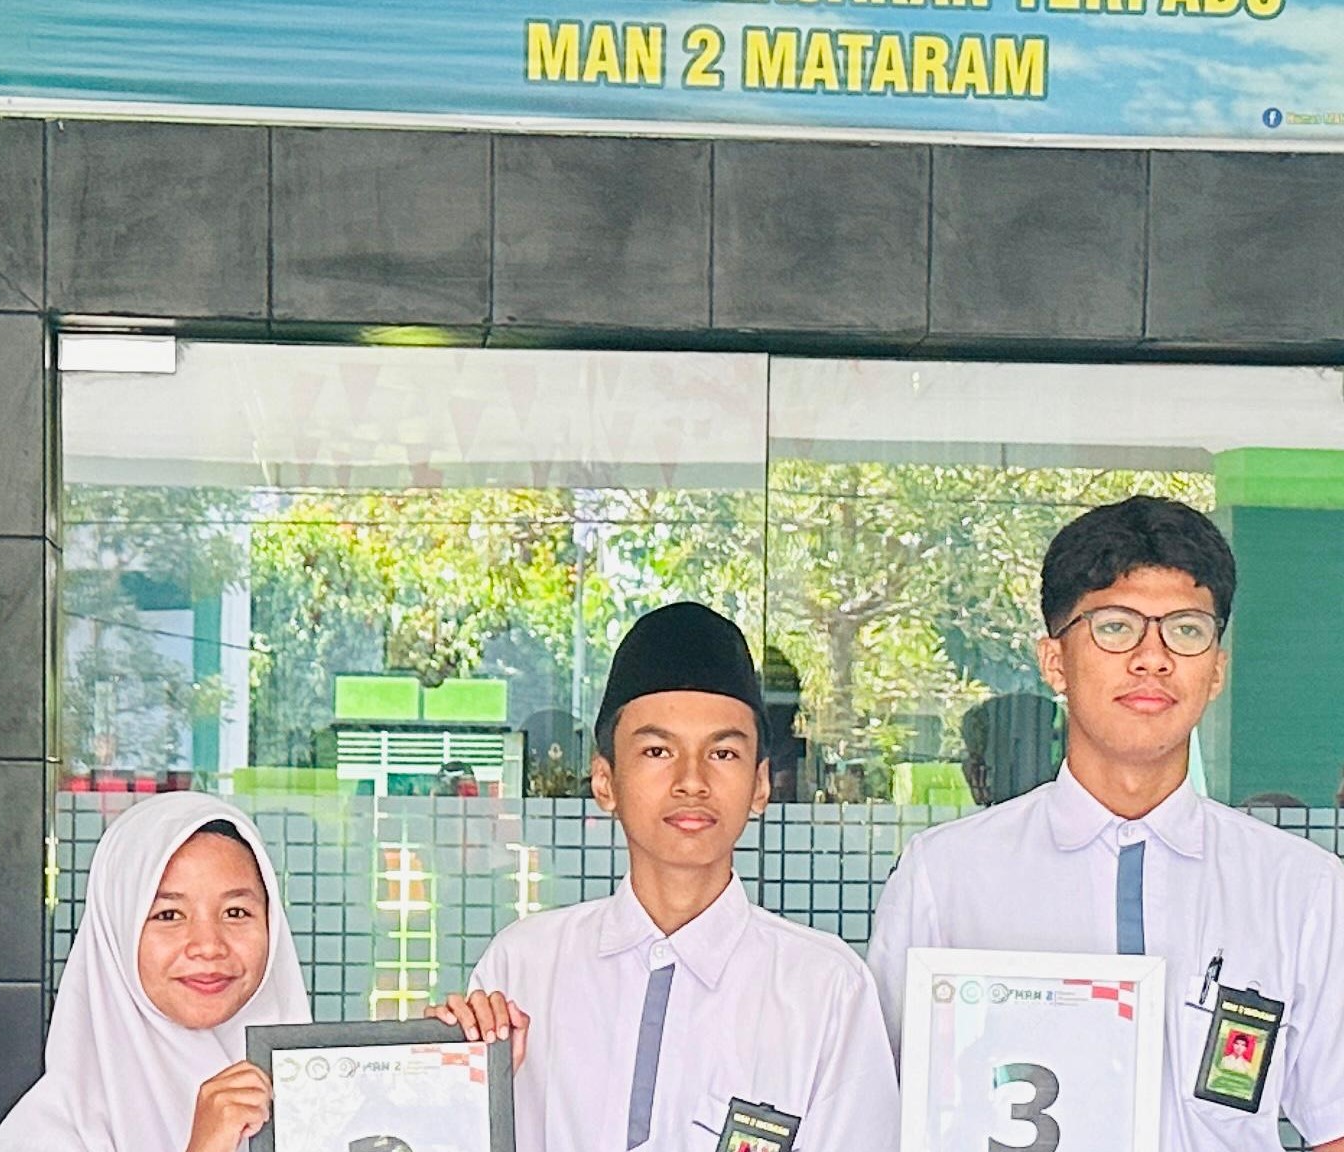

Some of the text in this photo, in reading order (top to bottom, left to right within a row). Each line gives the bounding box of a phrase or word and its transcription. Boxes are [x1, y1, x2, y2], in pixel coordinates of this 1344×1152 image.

[526, 20, 1049, 98] MAN 2 MATARAM
